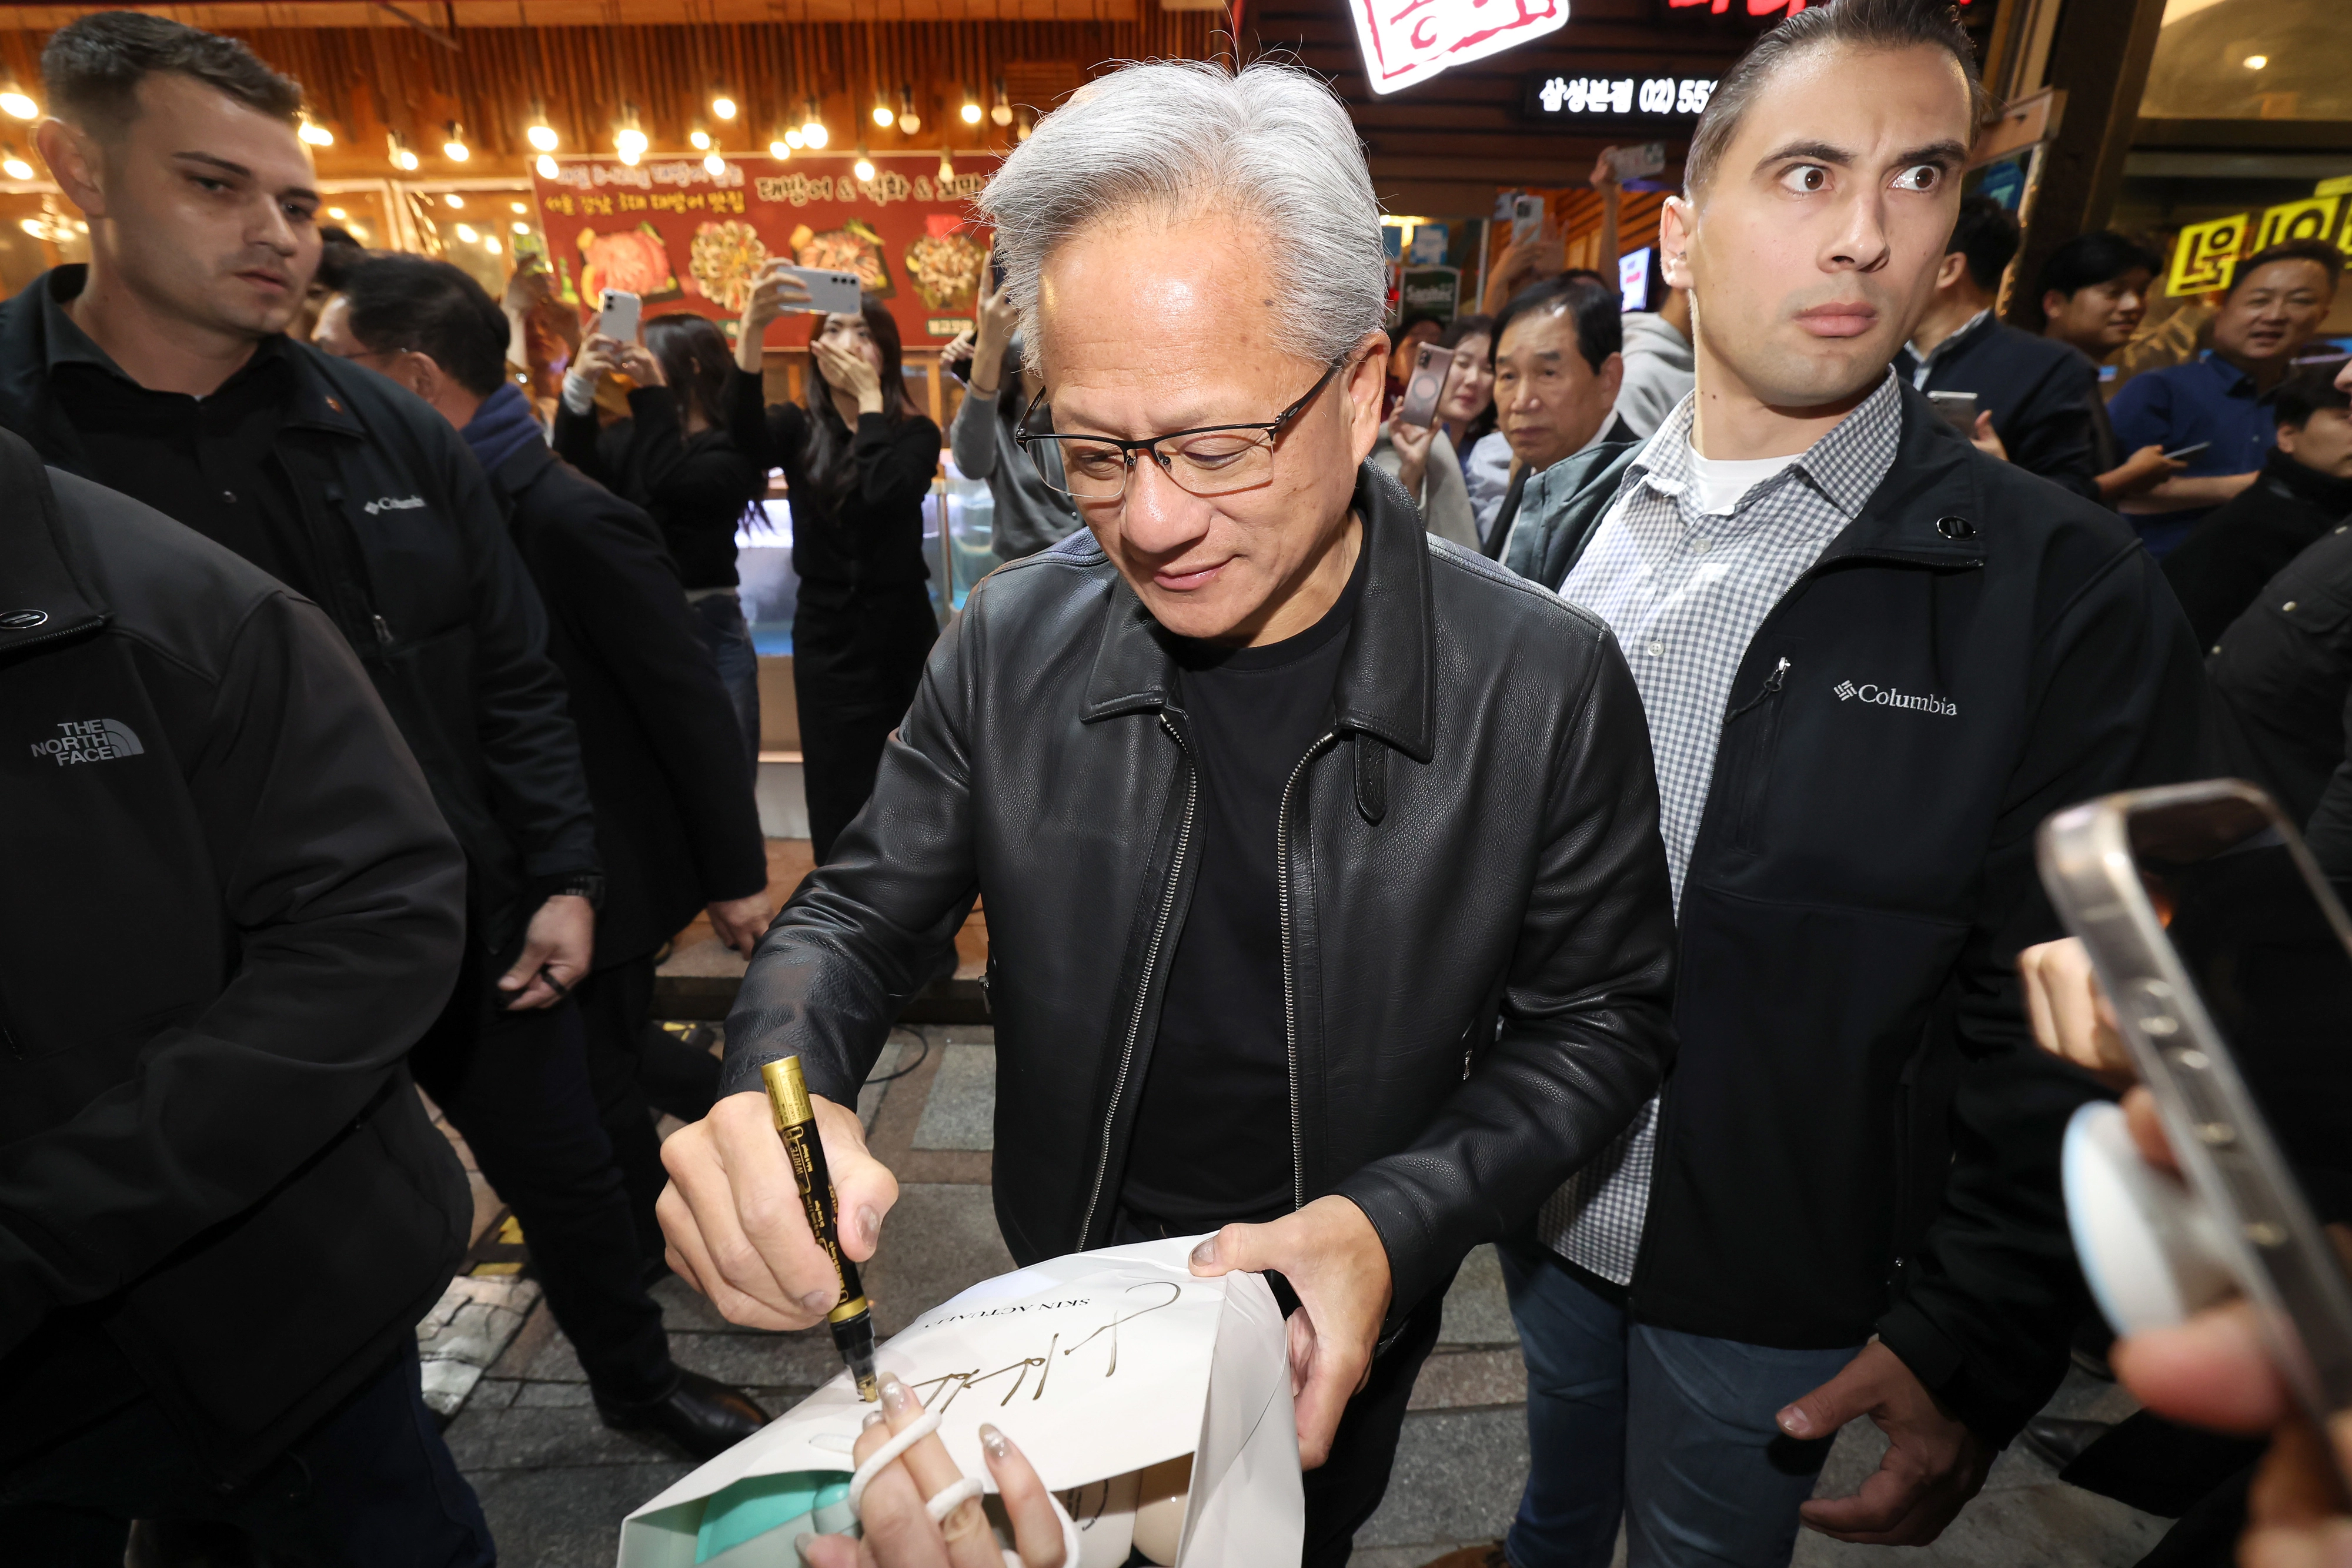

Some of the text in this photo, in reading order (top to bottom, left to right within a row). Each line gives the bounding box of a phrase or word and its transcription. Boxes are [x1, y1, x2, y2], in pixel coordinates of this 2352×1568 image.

[1539, 77, 1634, 113] 삼성본점
[1676, 79, 1718, 113] 55
[754, 172, 834, 207] 대방어
[836, 176, 857, 202] &
[913, 175, 934, 202] &
[544, 193, 576, 216] 서울
[579, 193, 614, 216] 강남
[649, 191, 705, 214] 대방어
[707, 190, 745, 213] 맛집
[1858, 684, 1957, 716] Columbia
[57, 719, 104, 735] THE
[31, 733, 111, 757] NORTH
[55, 746, 115, 766] FACE
[790, 1146, 804, 1175] WRITE
[1038, 1298, 1091, 1310] SKIN
